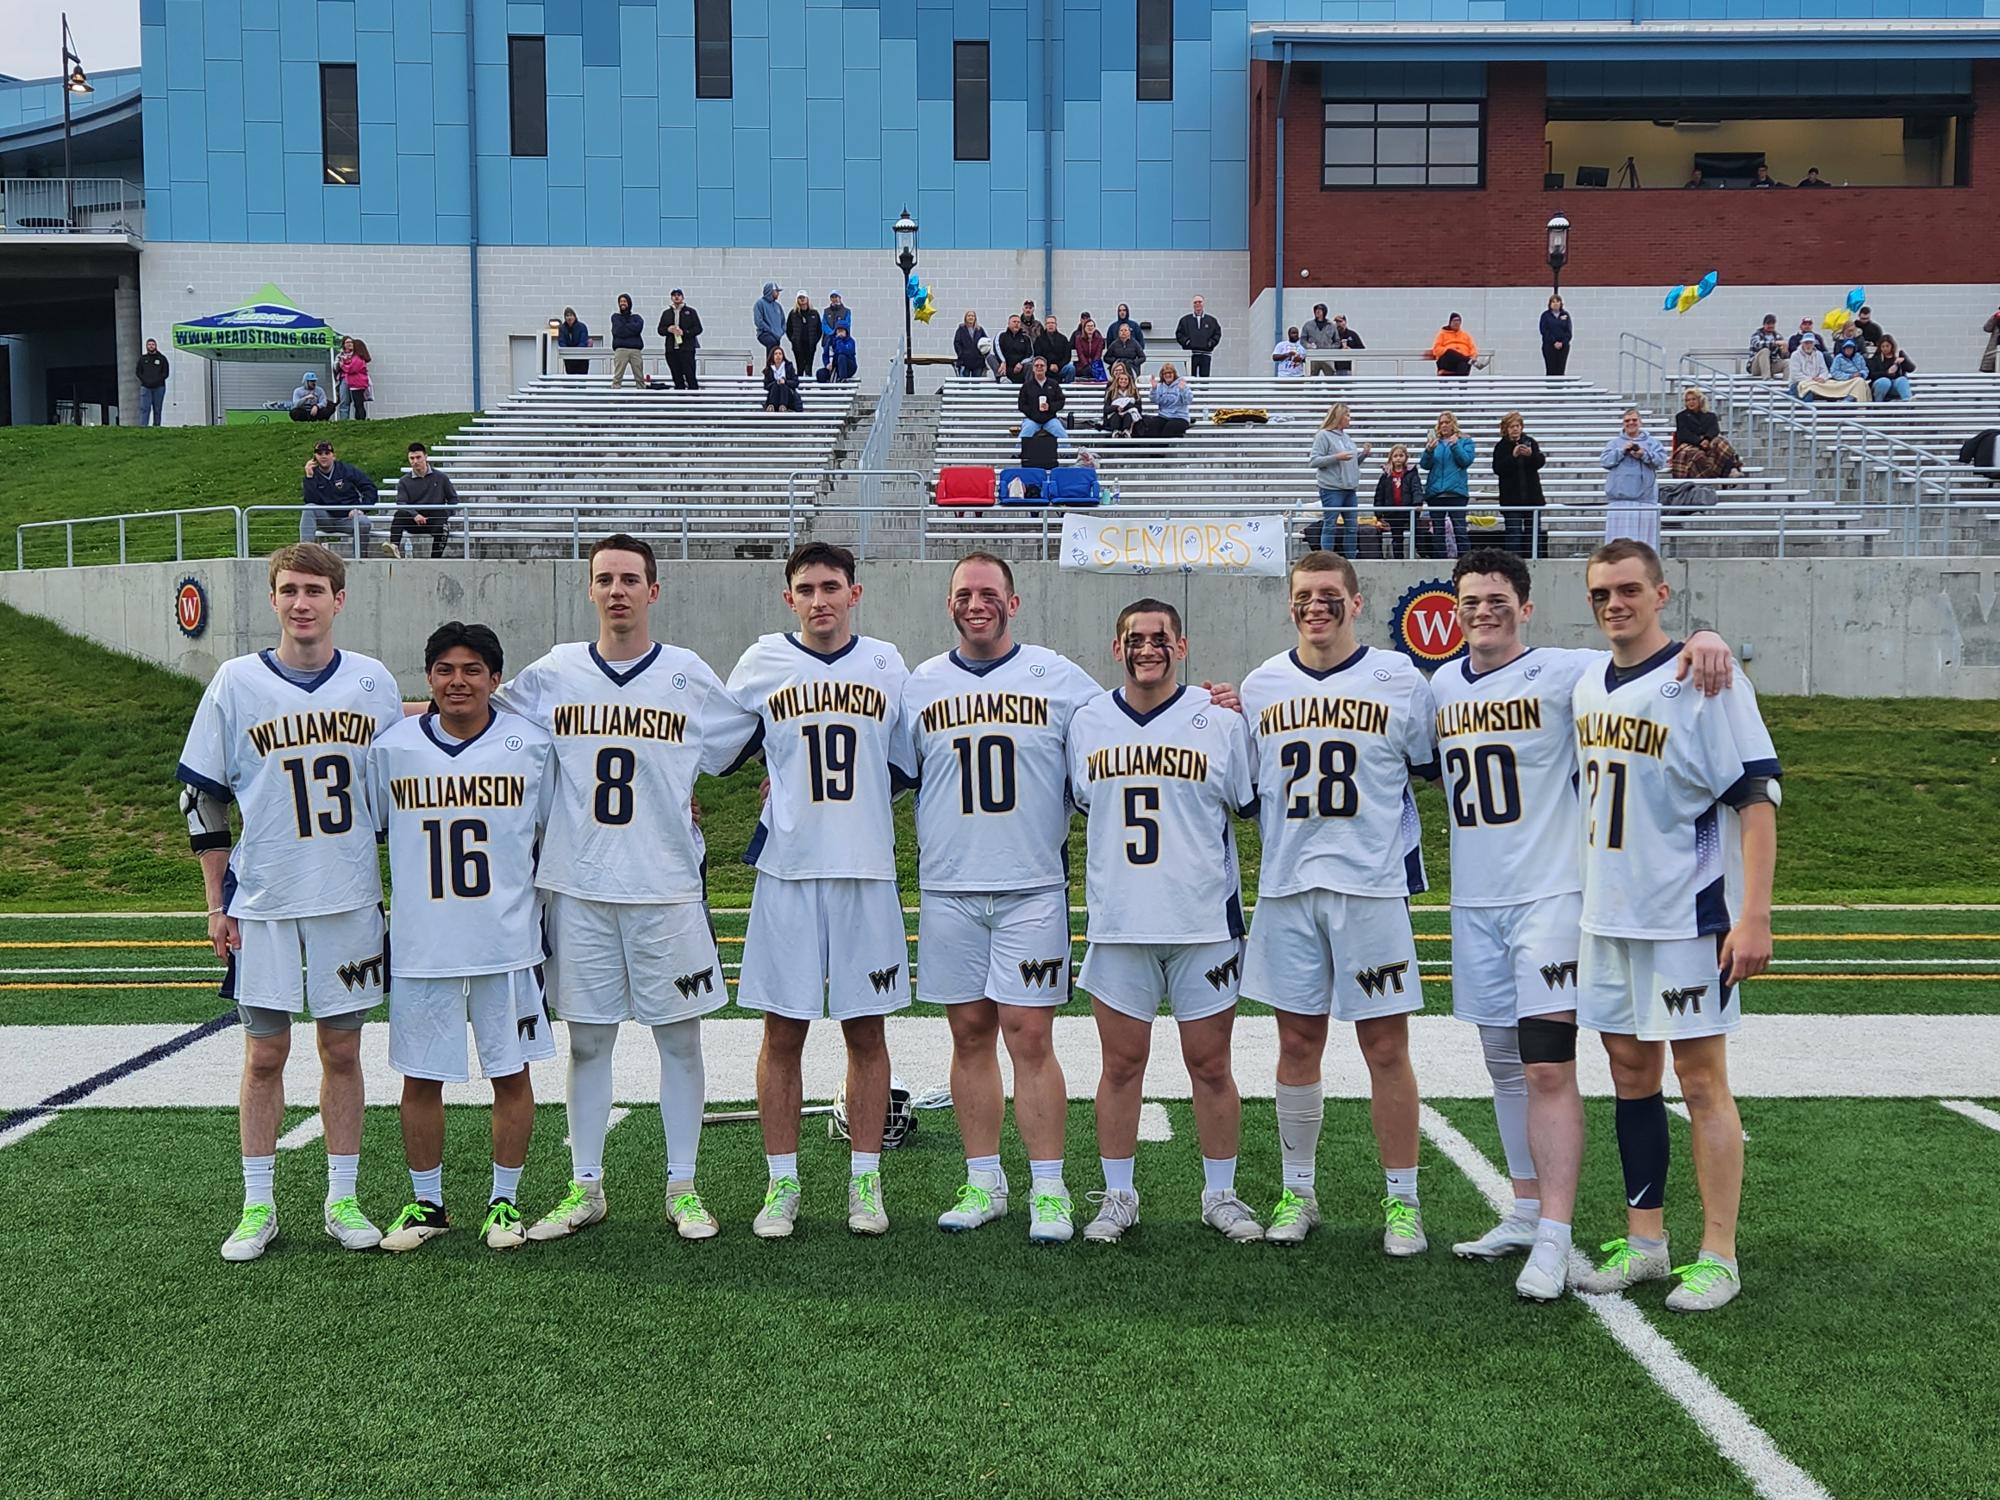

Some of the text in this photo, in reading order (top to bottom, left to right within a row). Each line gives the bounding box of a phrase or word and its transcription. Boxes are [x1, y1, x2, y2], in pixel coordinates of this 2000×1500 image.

[175, 328, 326, 345] WWW.HEADSTRONG.ORG
[1094, 524, 1251, 567] SENIORS
[1148, 525, 1163, 537] #19
[1247, 521, 1260, 532] #8
[182, 597, 197, 621] W
[1412, 610, 1457, 646] W
[767, 681, 887, 723] WILLIAMSON
[920, 693, 1049, 734] WILLIAMSON
[1259, 696, 1390, 738] WILLIAMSON
[553, 704, 687, 744] WILLIAMSON
[800, 722, 858, 803] 19
[952, 733, 1018, 816] 10
[1087, 745, 1208, 783] WILLIAMSON
[1279, 739, 1360, 820] 28
[281, 753, 353, 840] 13
[390, 775, 525, 810] WILLIAMSON
[593, 745, 637, 828] 8
[1445, 743, 1522, 827] 20
[1123, 785, 1161, 867] 5
[420, 817, 491, 901] 16
[336, 953, 383, 993] WT
[673, 965, 714, 1000] WT
[868, 963, 900, 995] WT
[1018, 956, 1065, 989] WT
[1204, 952, 1239, 992] WT
[1355, 960, 1410, 999] WT
[1661, 985, 1709, 1017] WT
[517, 1014, 539, 1043] T
